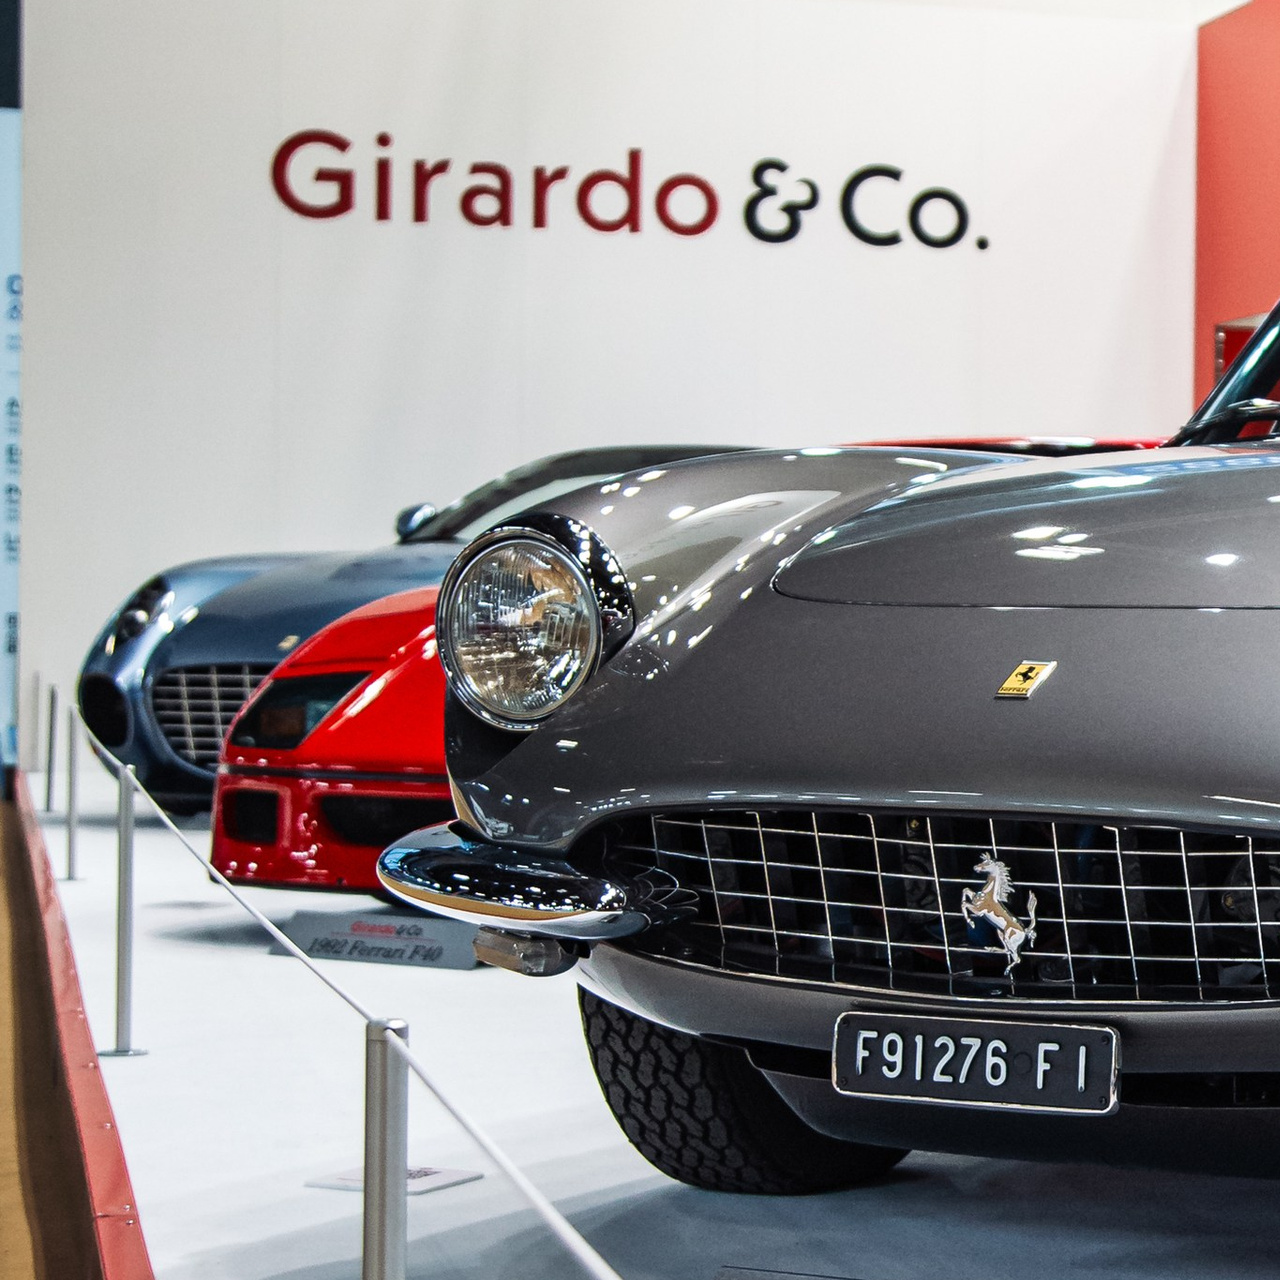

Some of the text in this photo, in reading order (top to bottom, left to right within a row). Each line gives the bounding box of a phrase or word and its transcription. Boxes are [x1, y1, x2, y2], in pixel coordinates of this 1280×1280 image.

[270, 128, 721, 237] Girardo
[348, 939, 404, 959] Ferrari
[407, 944, 444, 962] F40
[855, 1030, 1008, 1087] F91276
